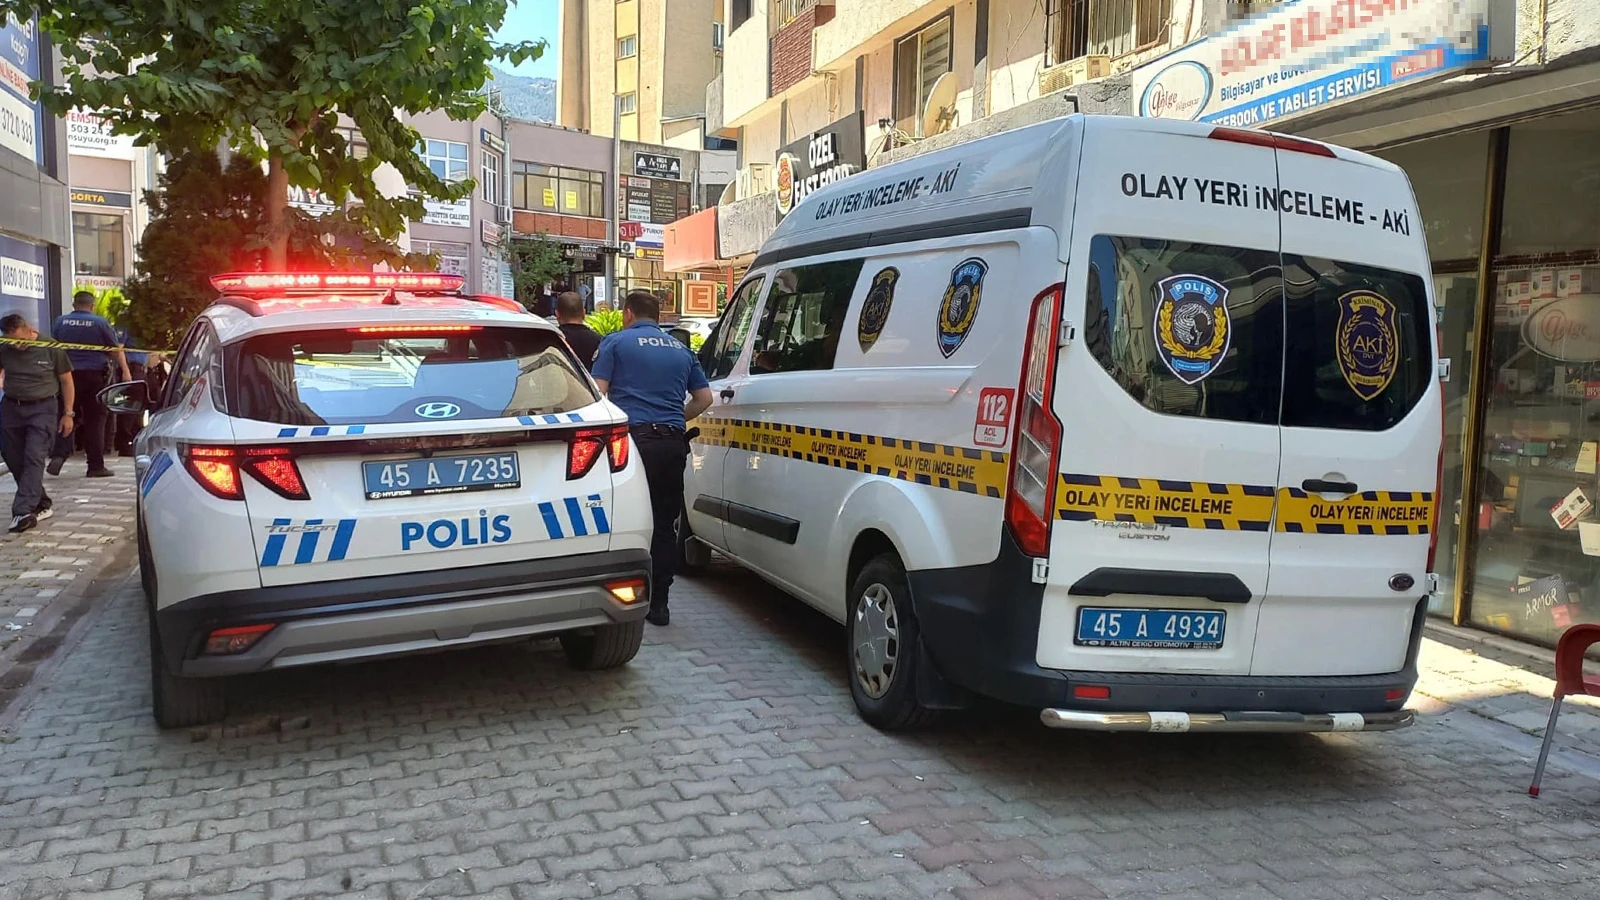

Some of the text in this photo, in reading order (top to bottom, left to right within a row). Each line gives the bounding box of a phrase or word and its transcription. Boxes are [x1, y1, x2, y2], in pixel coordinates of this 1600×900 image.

[1221, 76, 1265, 102] Bilgisayar
[1267, 72, 1279, 85] ve
[1260, 101, 1276, 120] VE
[1277, 86, 1325, 115] TABLET
[71, 123, 89, 134] 503
[91, 126, 104, 135] 24
[808, 133, 836, 169] ÖZEL
[815, 197, 842, 221] OLAY
[929, 161, 961, 196] AKİ
[1121, 173, 1188, 202] OLAY
[1382, 208, 1410, 237] AKİ
[692, 287, 708, 308] E
[1175, 281, 1212, 296] POLİS
[983, 394, 1008, 422] 112
[812, 441, 825, 455] OLAY
[380, 457, 514, 488] 45 A 7235
[894, 454, 914, 470] OLAY
[382, 489, 412, 498] HYUNDAI
[1065, 490, 1111, 508] OLAY
[1310, 504, 1345, 519] OLAY
[401, 509, 512, 551] POLİS
[1091, 519, 1172, 532] TRANSIT
[1118, 532, 1171, 542] CUSTOM
[1525, 587, 1558, 620] ARMOR
[1094, 613, 1219, 639] 45 A 4934
